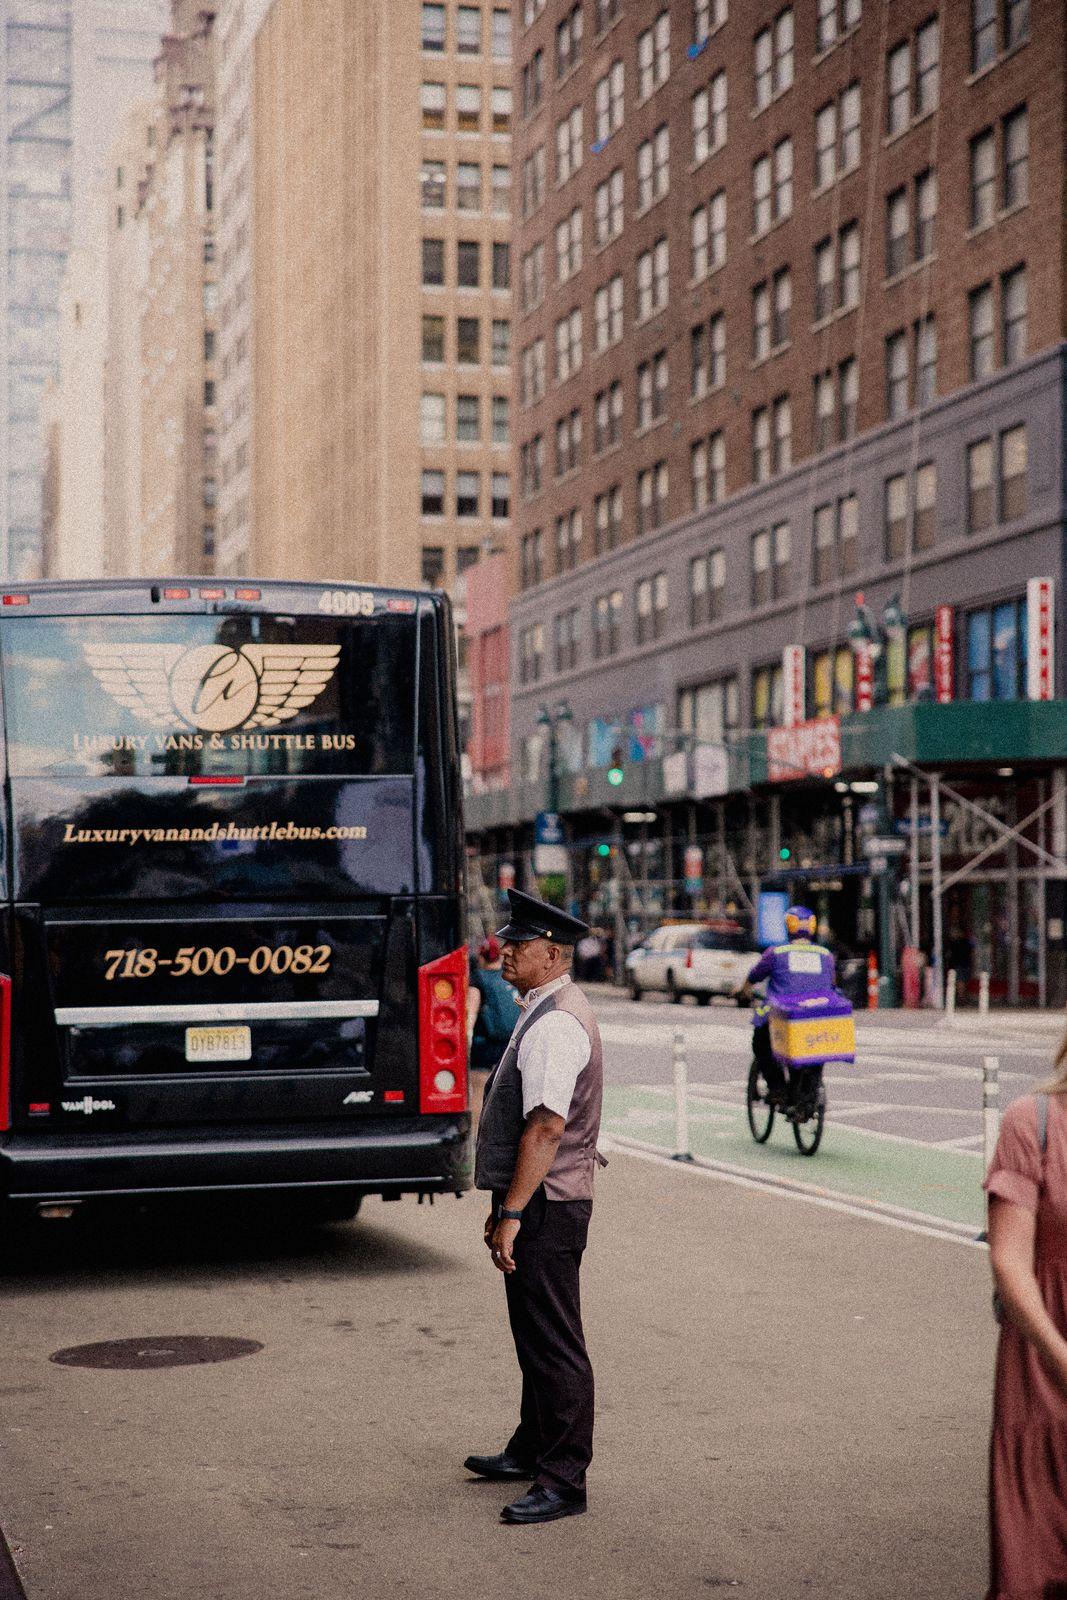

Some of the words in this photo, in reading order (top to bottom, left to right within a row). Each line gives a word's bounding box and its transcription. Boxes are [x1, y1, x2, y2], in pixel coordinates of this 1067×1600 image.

[319, 591, 374, 616] 4005
[73, 733, 148, 750] LUURY
[155, 735, 203, 750] VANS
[210, 732, 225, 750] &
[230, 735, 315, 750] SHUTTLE
[321, 735, 356, 750] BUS
[63, 822, 368, 845] Luxuryvanandshuttlebus.com
[104, 944, 332, 980] 718-500-0082
